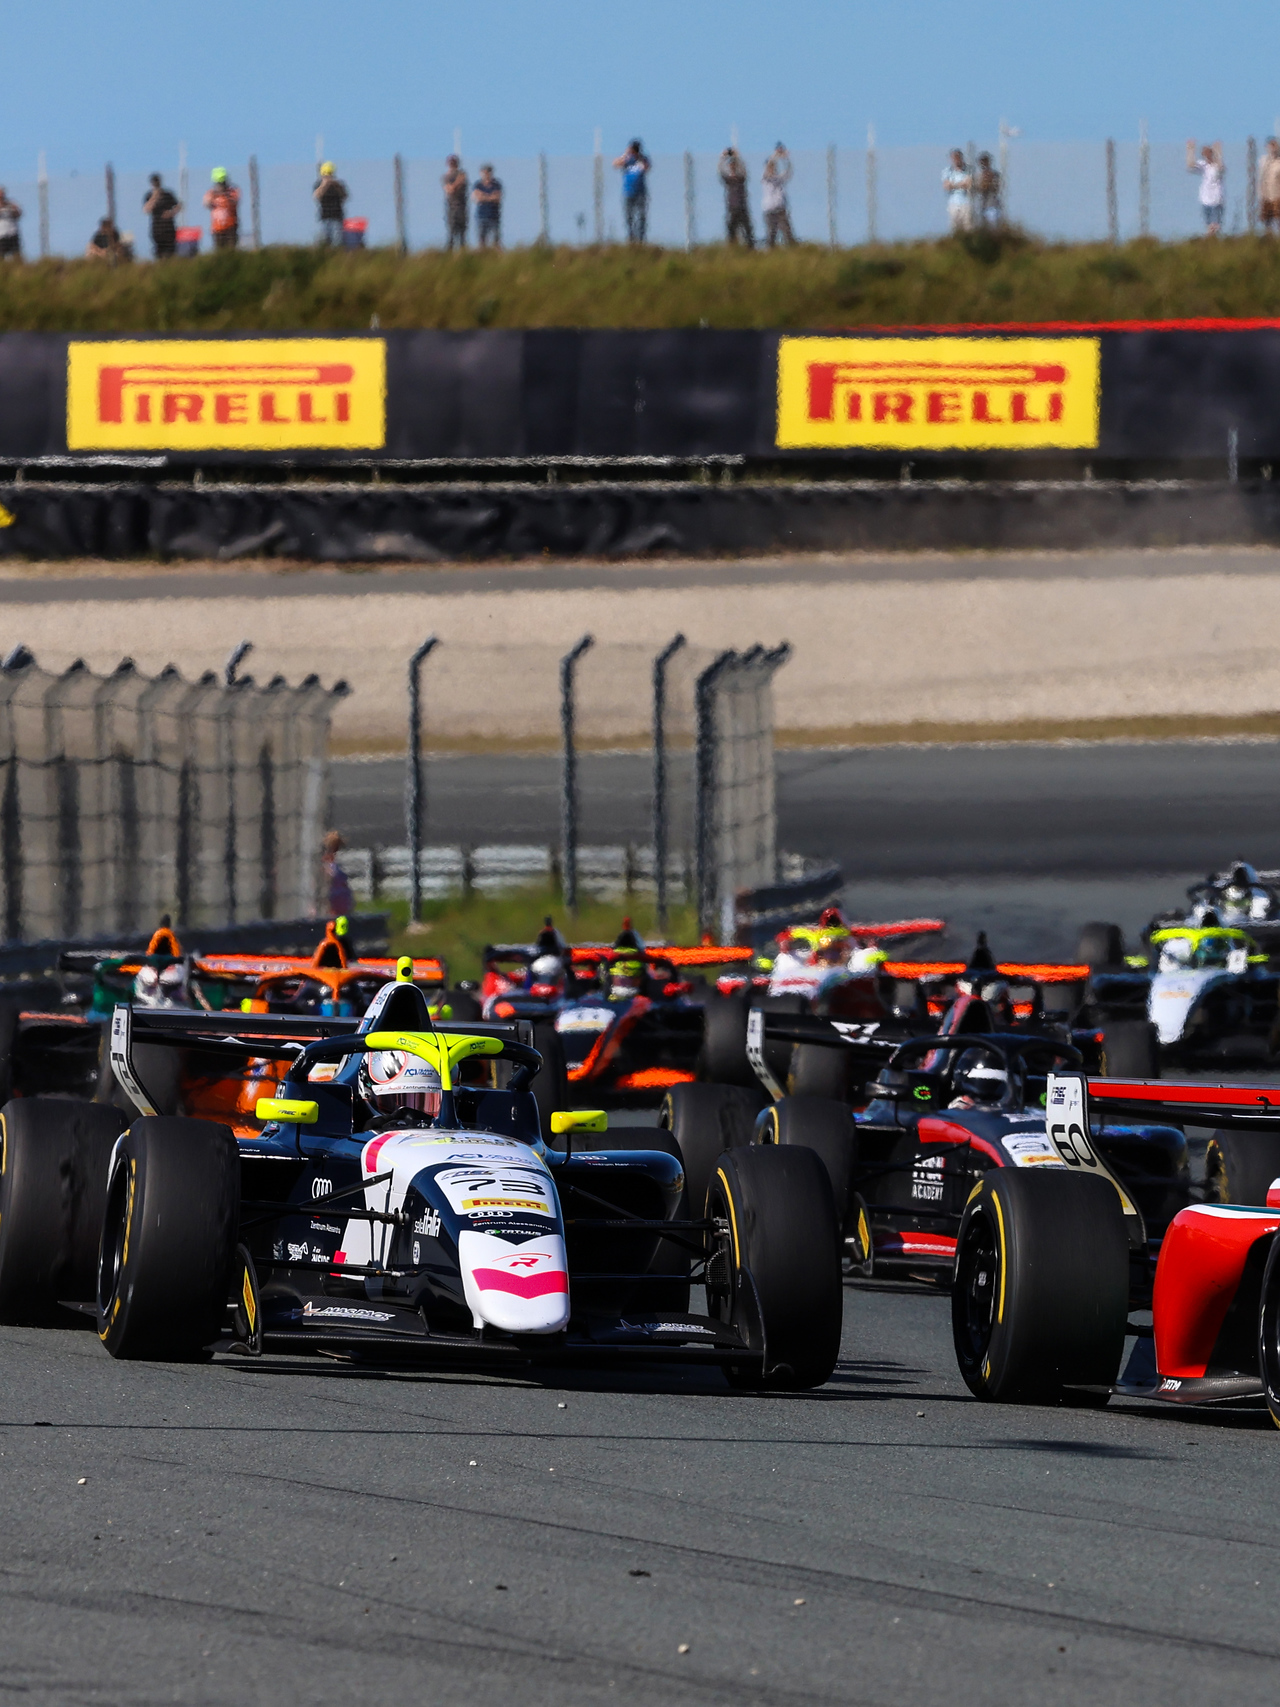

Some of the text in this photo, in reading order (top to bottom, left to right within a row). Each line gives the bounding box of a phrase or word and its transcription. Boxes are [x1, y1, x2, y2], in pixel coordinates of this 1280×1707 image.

[98, 365, 354, 424] PIRELLI
[808, 363, 1066, 423] PIRELLI
[1051, 1123, 1098, 1168] 60
[450, 1178, 546, 1196] 73
[472, 1199, 542, 1209] PIRELLI
